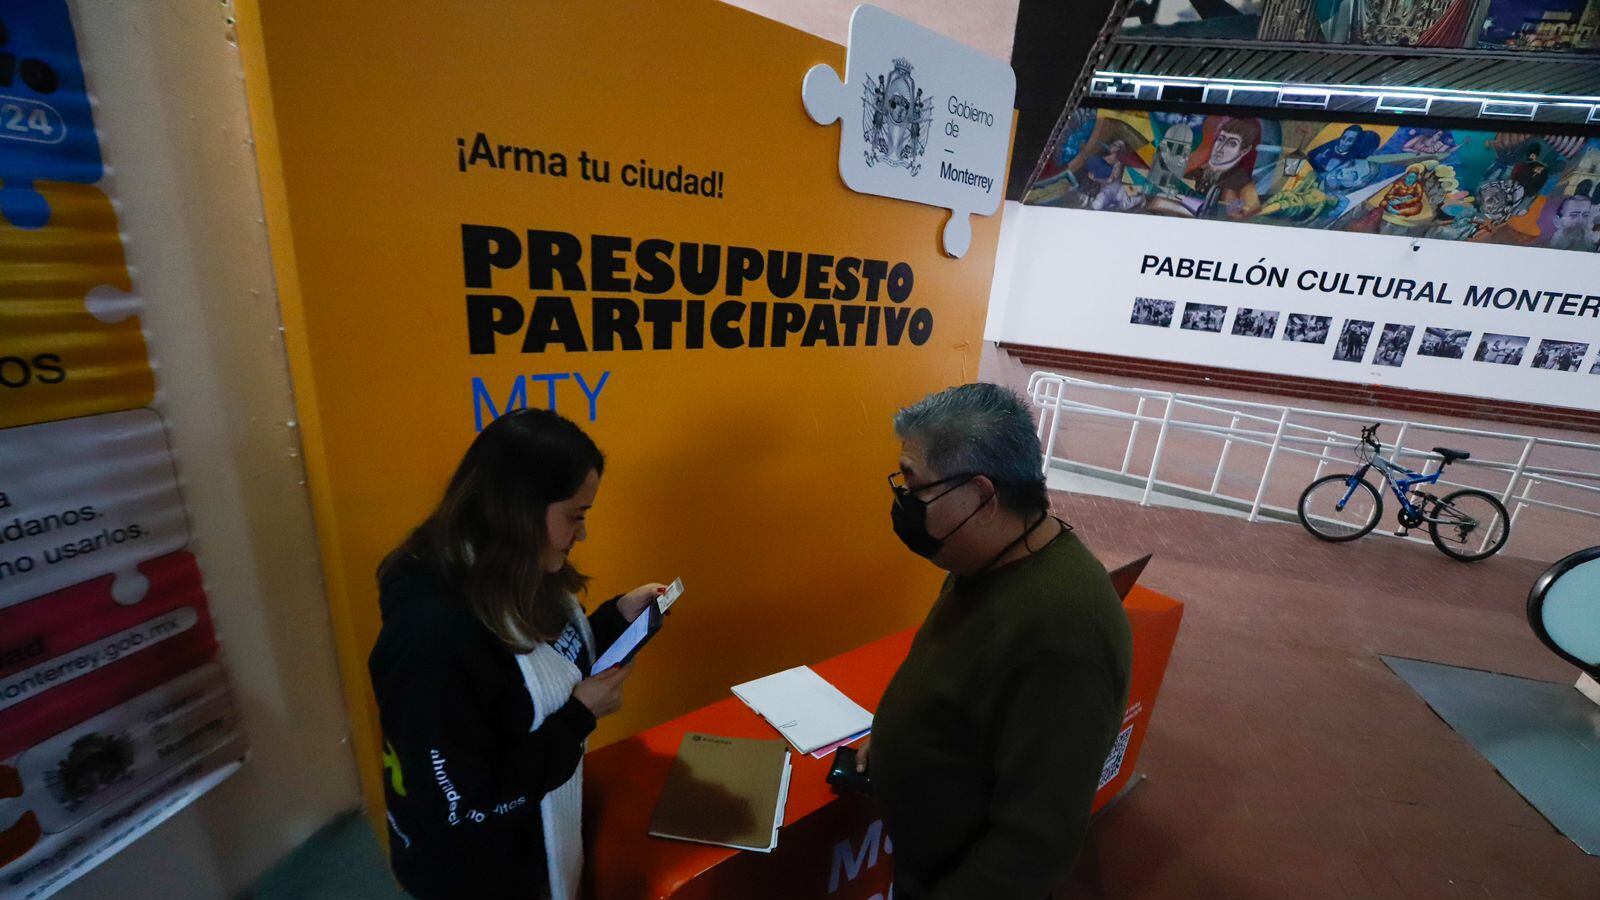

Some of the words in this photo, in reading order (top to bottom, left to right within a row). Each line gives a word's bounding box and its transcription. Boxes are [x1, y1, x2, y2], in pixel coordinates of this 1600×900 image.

[0, 103, 54, 135] 24
[945, 119, 960, 138] de
[947, 95, 994, 127] Gobierno
[457, 132, 567, 177] ¡Arma
[578, 151, 610, 183] tu
[620, 159, 724, 199] ciudad!
[940, 161, 994, 193] Monterrey
[461, 223, 914, 303] PRESUPUESTO
[1140, 254, 1288, 288] PABELLÓN
[1296, 269, 1453, 304] CULTURAL
[1463, 285, 1600, 318] MONTER
[466, 294, 934, 354] PARTICIPATIVO
[471, 371, 610, 432] MTY
[0, 506, 103, 544] danos.
[43, 524, 149, 564] usarlos.
[0, 620, 177, 700] onterrey.gob.mx
